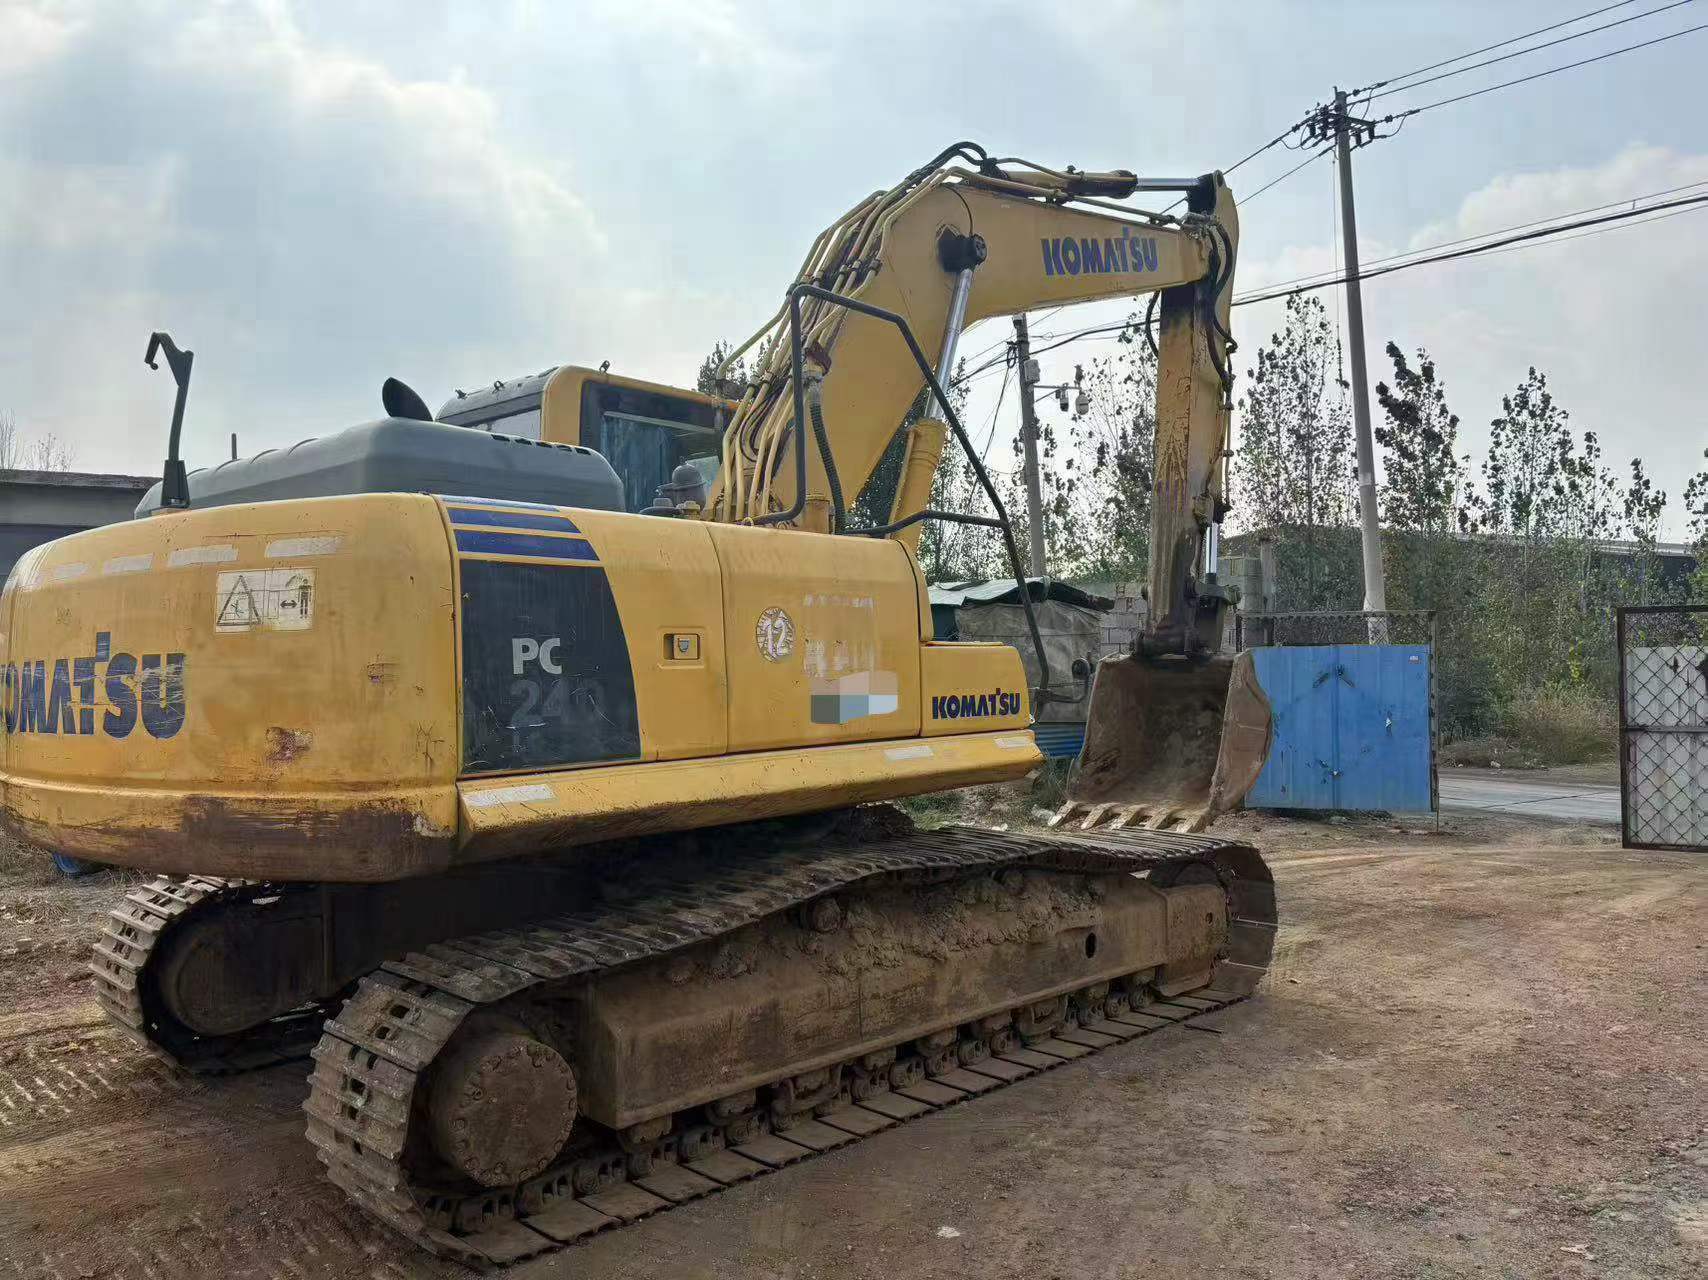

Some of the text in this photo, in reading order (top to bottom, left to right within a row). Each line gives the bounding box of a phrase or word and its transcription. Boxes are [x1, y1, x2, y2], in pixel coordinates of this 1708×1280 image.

[1041, 226, 1159, 276] KOMATSU
[512, 637, 562, 675] PC
[932, 688, 1021, 720] KOMATSU
